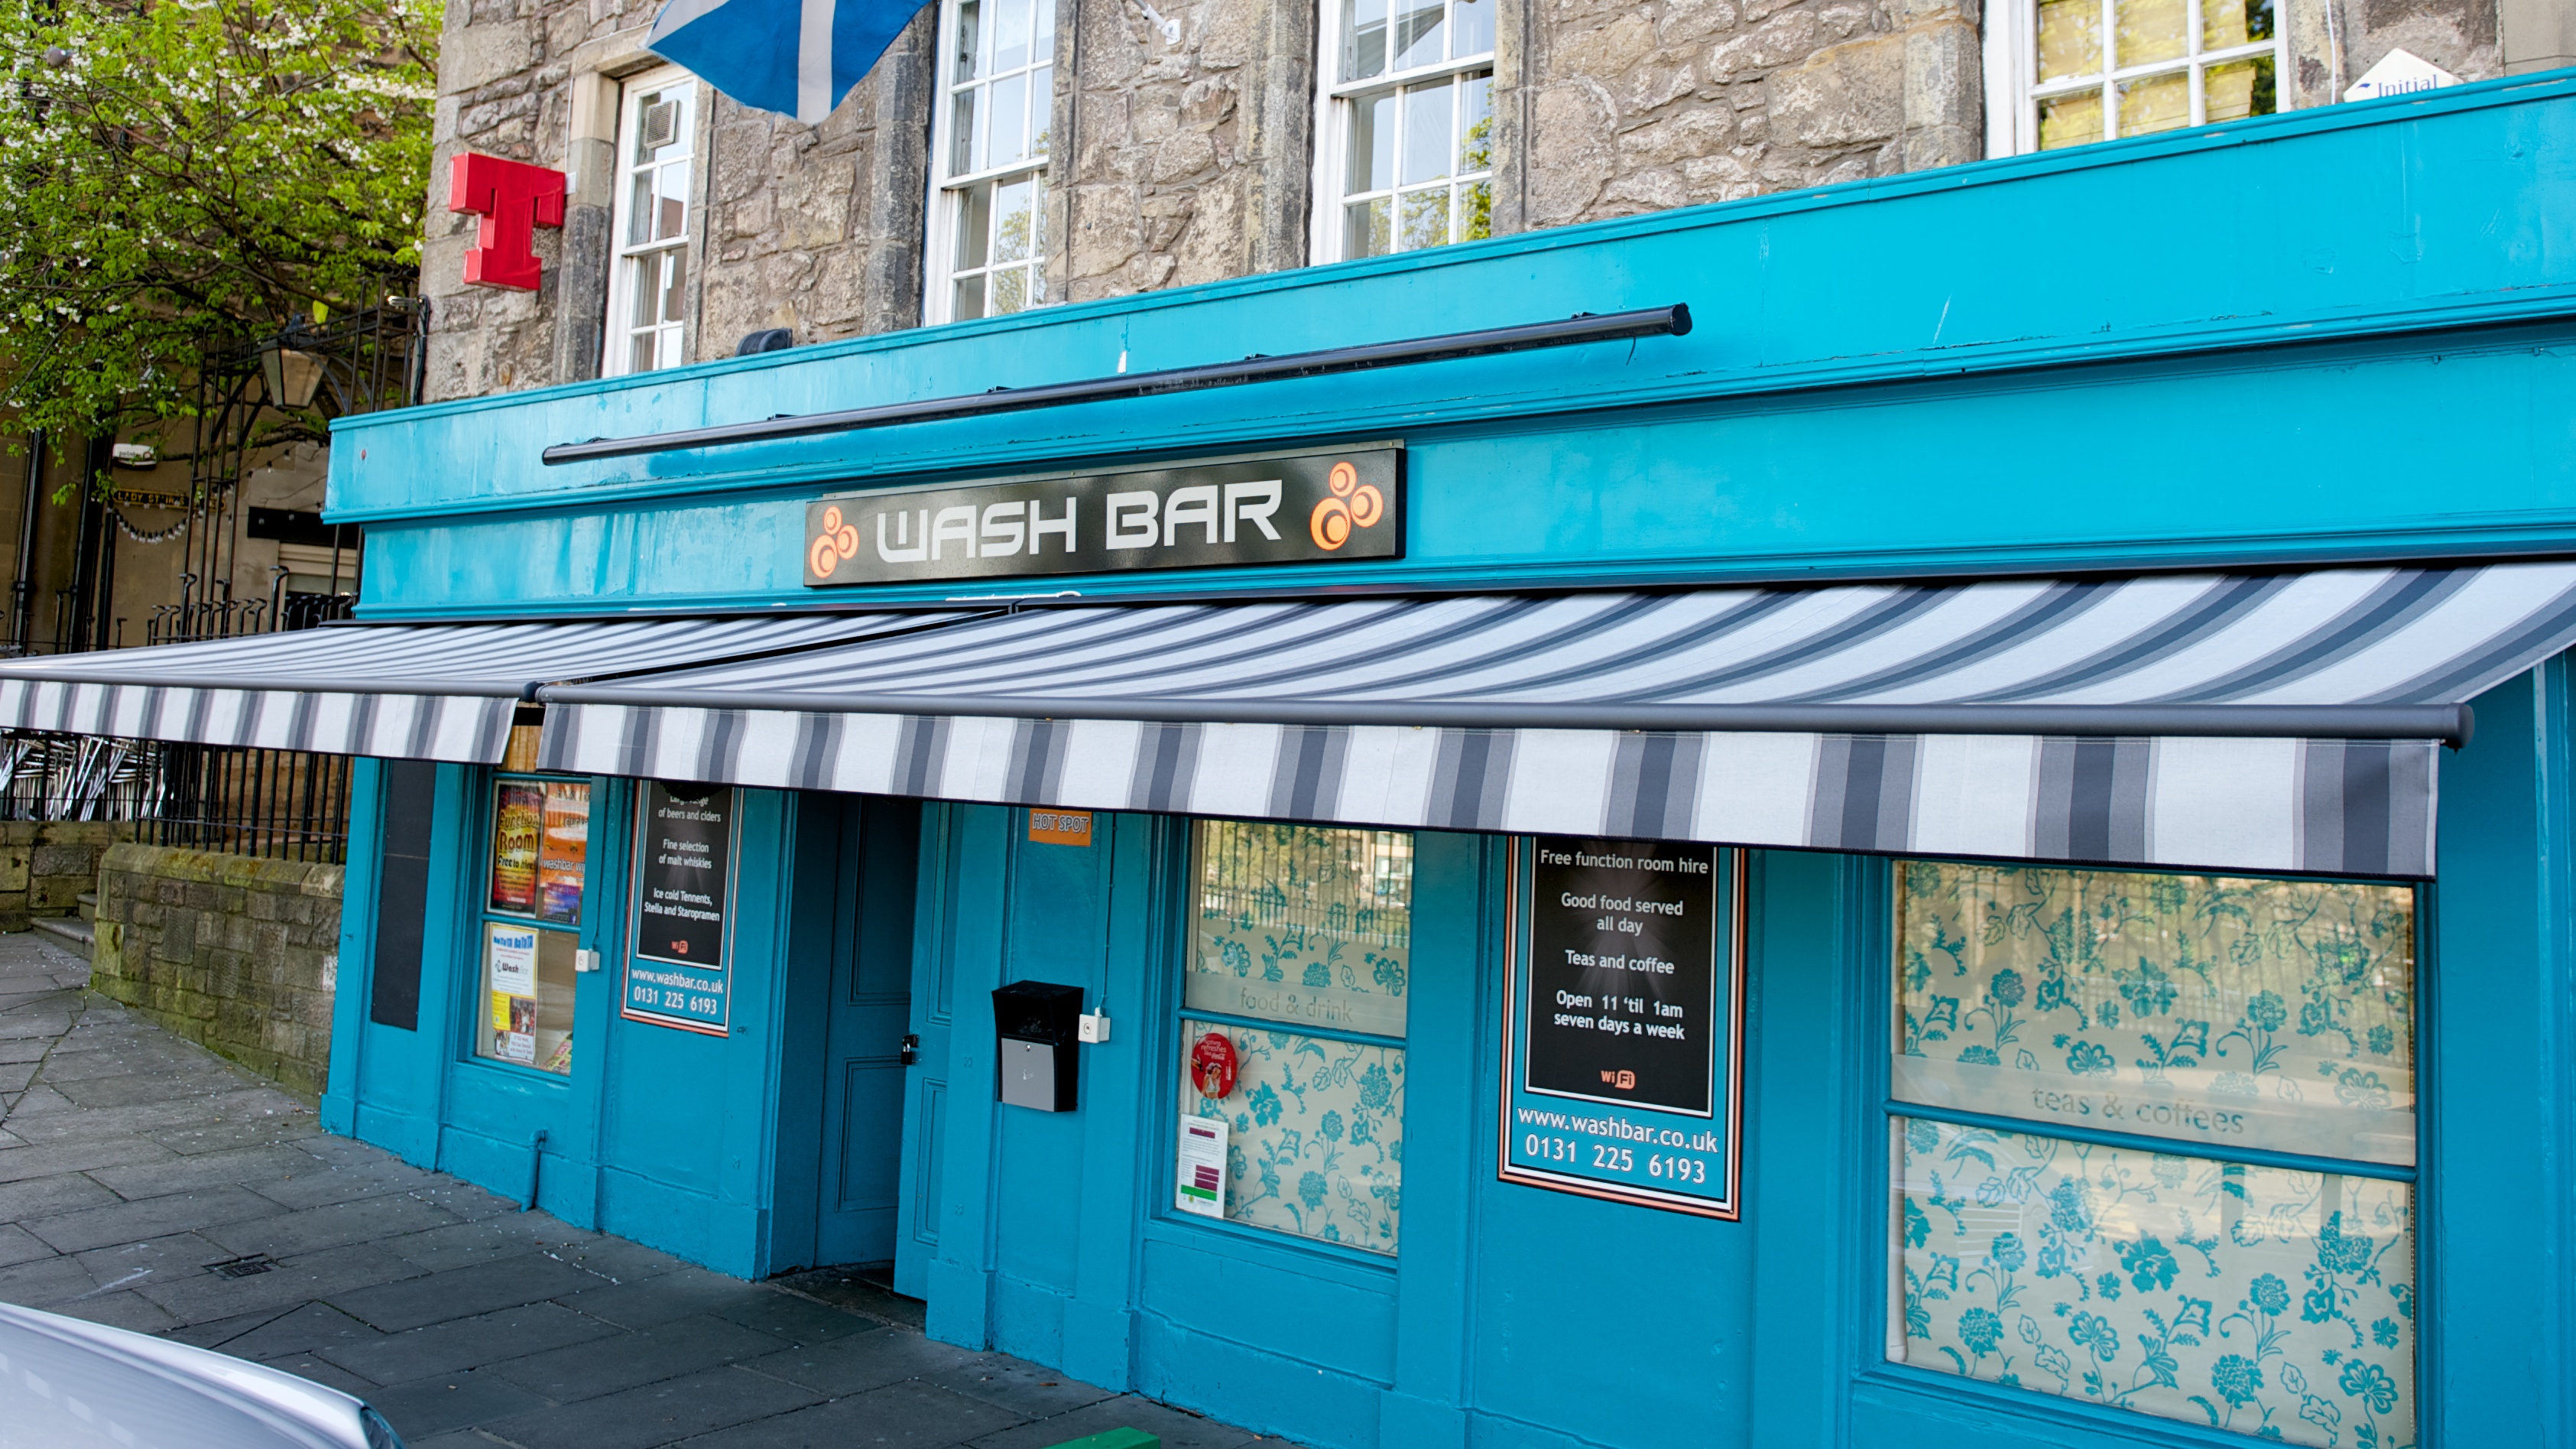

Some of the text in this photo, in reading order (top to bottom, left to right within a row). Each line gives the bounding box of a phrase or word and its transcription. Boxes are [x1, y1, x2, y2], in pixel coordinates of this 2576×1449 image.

[2378, 74, 2438, 98] Initial
[877, 479, 1283, 563] WASH BAR
[658, 807, 721, 823] of beers and ciders
[1033, 813, 1088, 833] HOT SPOT
[663, 839, 709, 853] Fine selection
[543, 857, 574, 872] washbar
[658, 853, 712, 869] of malt whiskies
[1540, 850, 1709, 874] Free function room hire
[653, 887, 713, 908] Ice cold Tennents,
[1560, 892, 1684, 916] Good food served
[644, 902, 720, 922] Stella and Staropramen
[1597, 915, 1643, 937] all day
[501, 962, 519, 975] Wash
[1565, 949, 1675, 974] Teas and coffee
[631, 968, 724, 994] www.washbar.co.uk
[634, 985, 717, 1015] 0131 225 6193
[1240, 986, 1353, 1023] food & drink
[1556, 989, 1593, 1009] Open
[1601, 995, 1618, 1011] 11
[1653, 1000, 1683, 1019] 1am
[1553, 1012, 1685, 1041] seven days a week
[2031, 1087, 2244, 1135] teas & coffees
[1517, 1107, 1719, 1154] www.washbar.co.uk
[1525, 1133, 1706, 1184] 0131 225 6193
